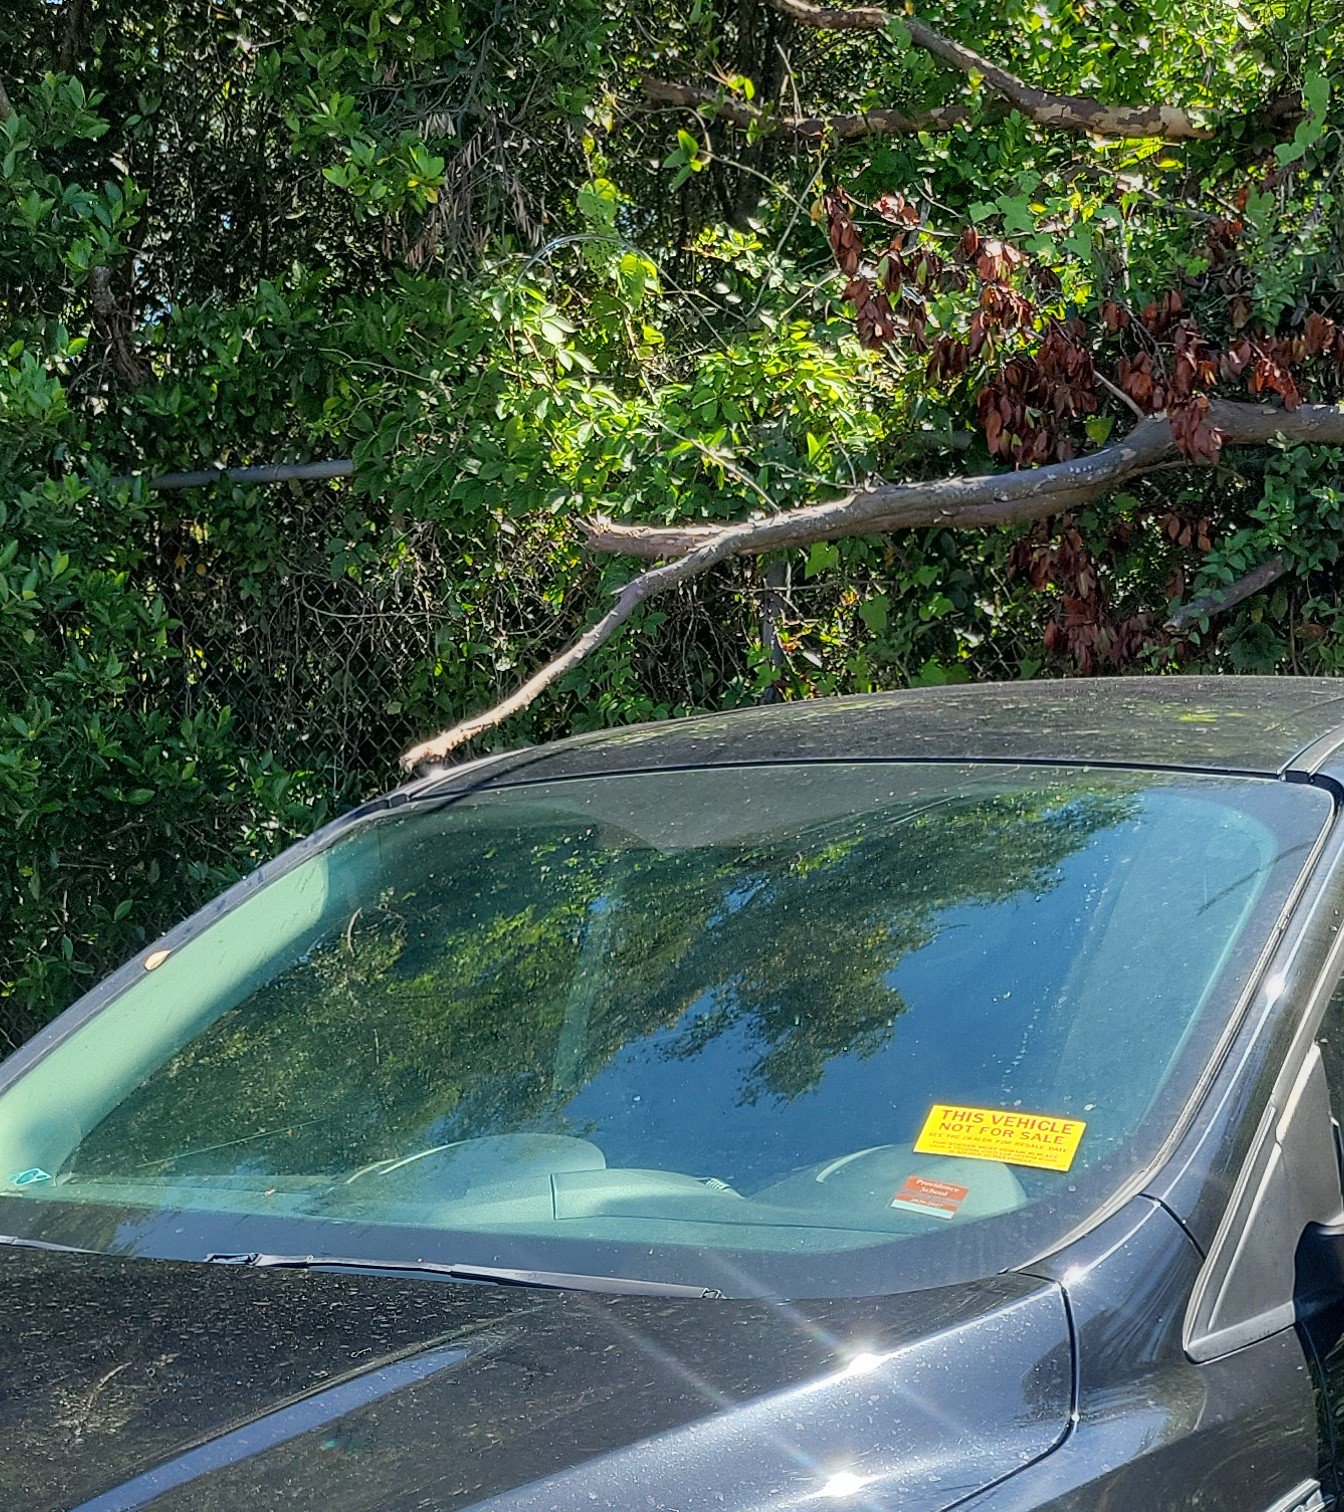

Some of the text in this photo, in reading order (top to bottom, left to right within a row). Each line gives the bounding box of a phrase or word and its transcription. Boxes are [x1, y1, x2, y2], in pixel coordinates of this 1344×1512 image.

[939, 1122, 1067, 1145] NOT FOR SALE
[941, 1109, 1074, 1135] THIS VEHICLE
